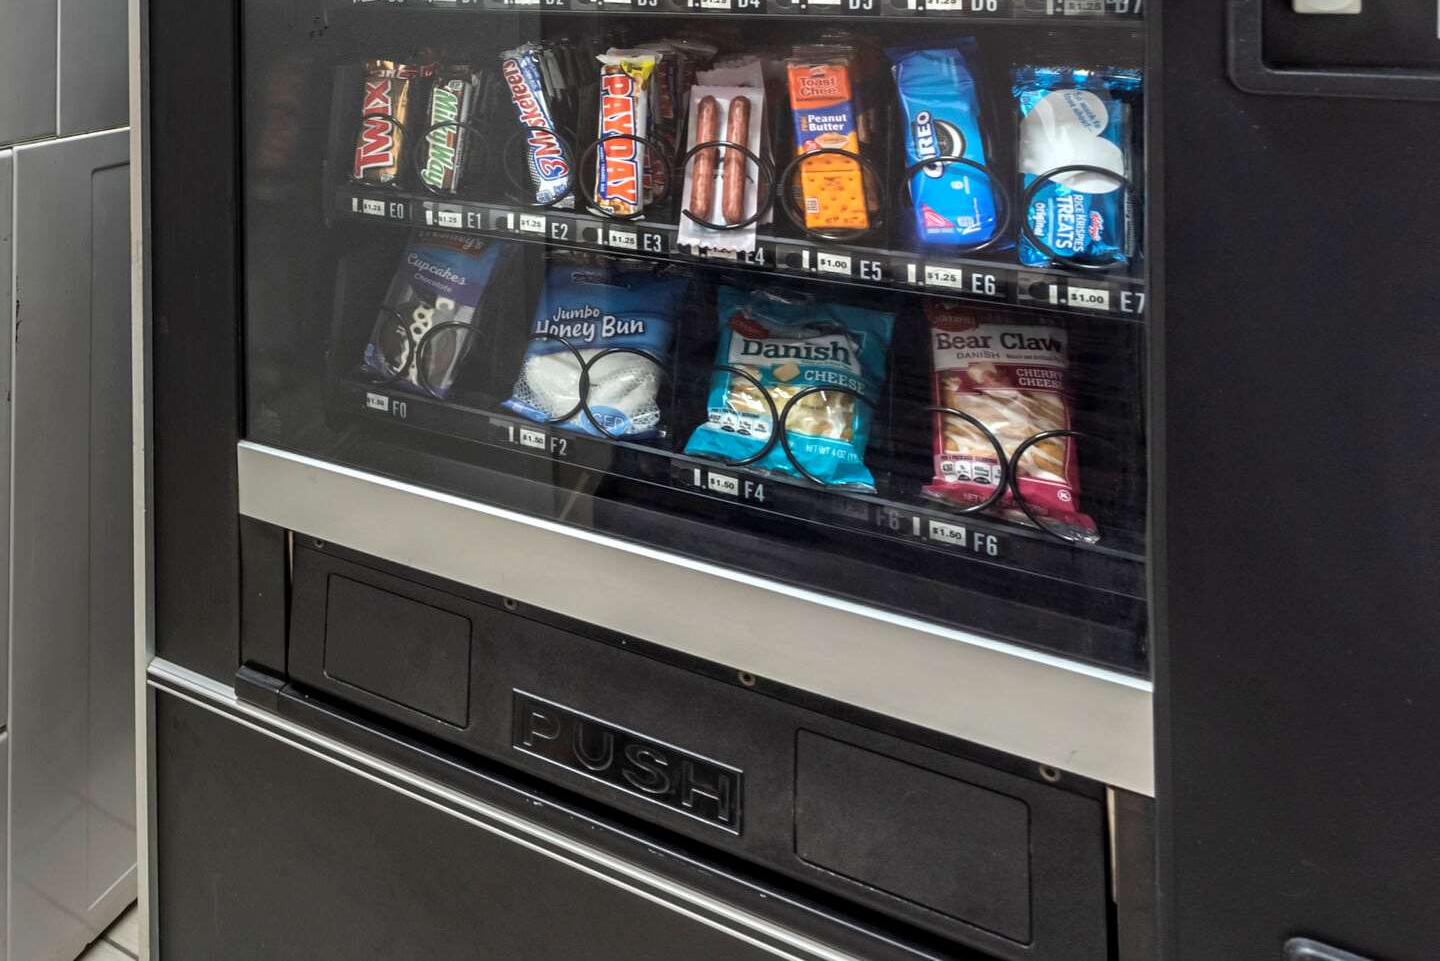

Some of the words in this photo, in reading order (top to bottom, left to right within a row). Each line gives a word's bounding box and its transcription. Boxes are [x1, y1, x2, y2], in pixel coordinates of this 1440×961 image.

[800, 78, 837, 87] Toast
[808, 114, 847, 123] Peanut
[809, 123, 844, 131] Butter
[354, 79, 394, 179] TWIX
[390, 202, 404, 218] E0
[1073, 194, 1084, 214] RICE
[468, 213, 481, 229] E1
[1056, 196, 1074, 248] TREATS
[552, 223, 568, 240] E2
[644, 234, 661, 252] E3
[408, 253, 467, 285] Cupcakes
[820, 259, 847, 269] $1.00
[860, 261, 882, 280] E5
[927, 271, 957, 282] $1.25
[972, 273, 995, 295] E6
[1071, 293, 1104, 304] $1.00
[1120, 291, 1145, 313] E7
[553, 304, 600, 321] Jumbo
[536, 319, 595, 342] Honey
[602, 316, 644, 336] Bun
[740, 338, 852, 366] Danish
[937, 333, 993, 351] Bear
[1000, 332, 1062, 353] Claw
[957, 351, 1000, 360] DANISH
[392, 400, 407, 419] F0
[550, 439, 567, 456] F2
[710, 478, 735, 490] $1.50
[745, 481, 766, 502] F4
[932, 526, 962, 540] $1.50
[974, 534, 998, 555] F6
[523, 710, 731, 822] PUSH
